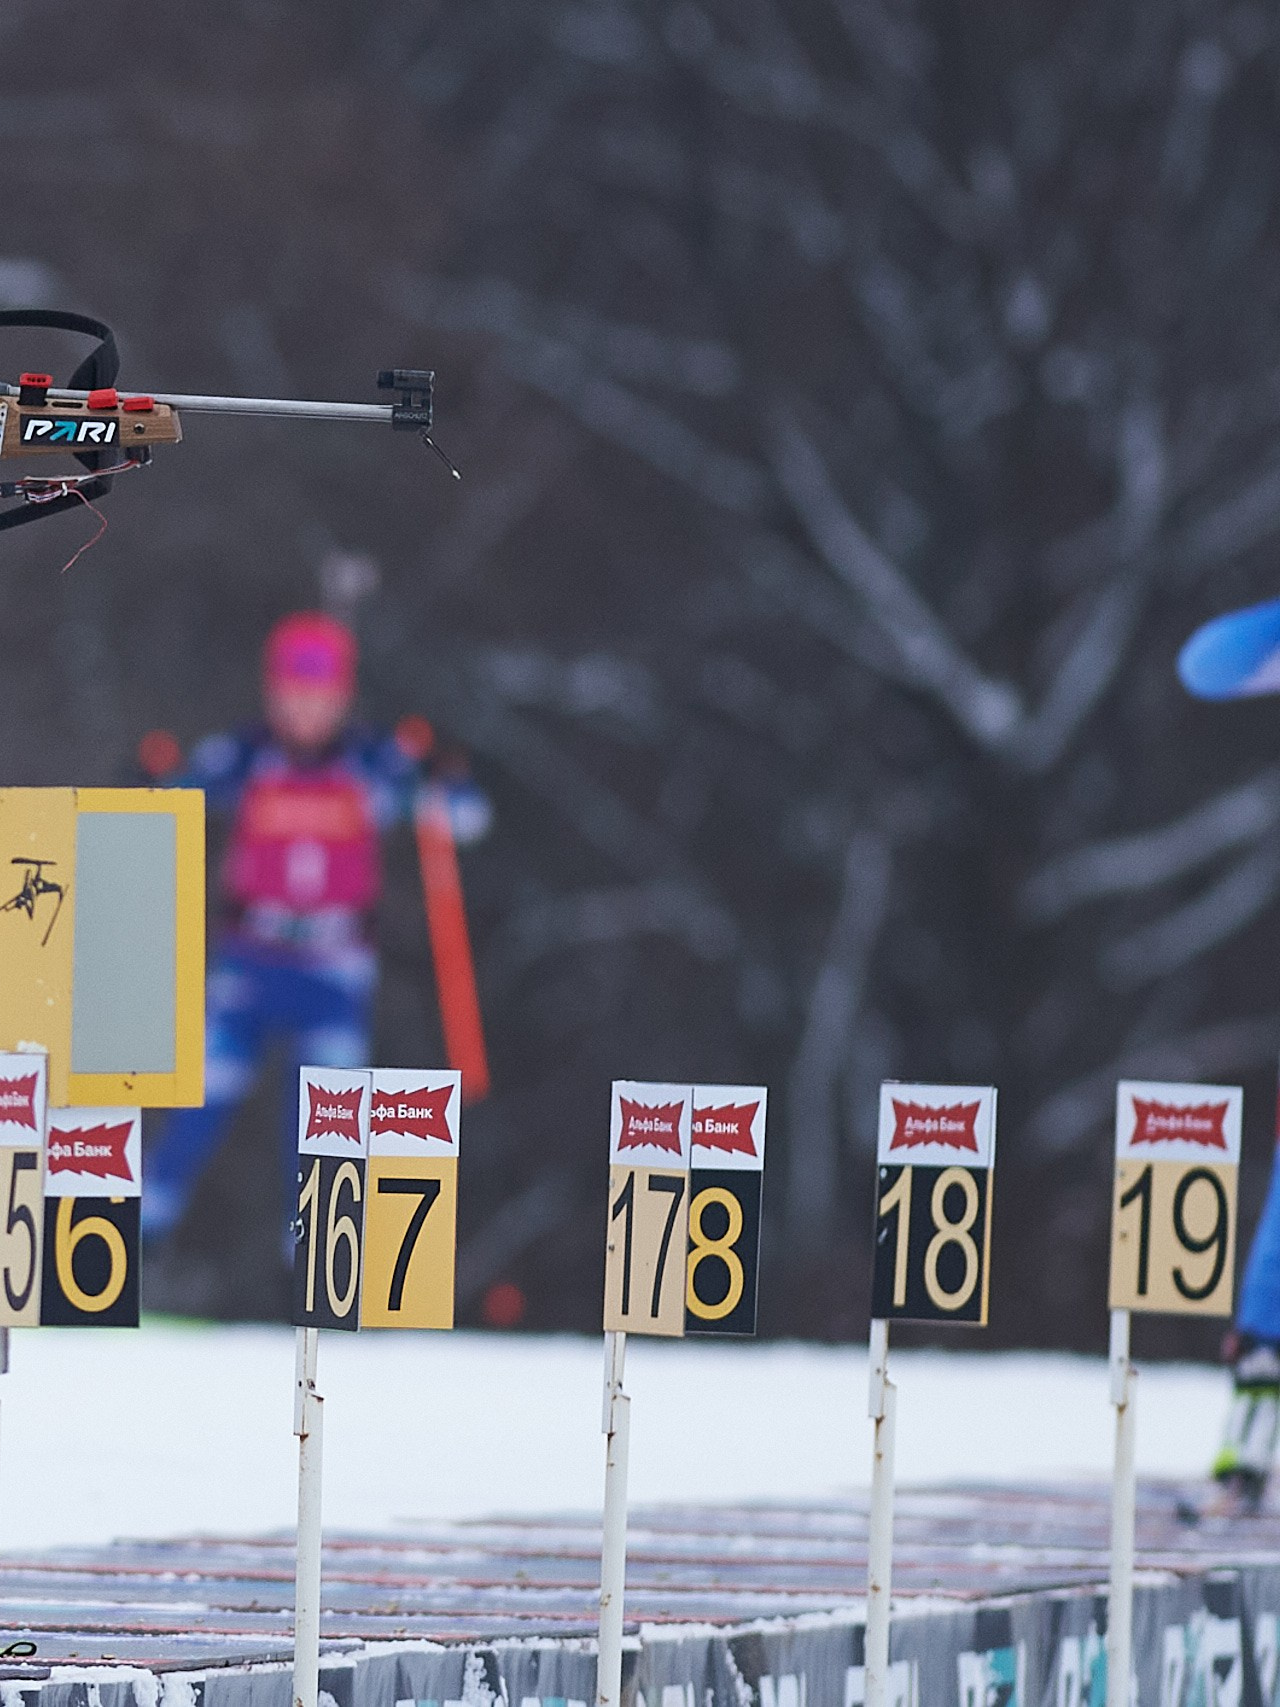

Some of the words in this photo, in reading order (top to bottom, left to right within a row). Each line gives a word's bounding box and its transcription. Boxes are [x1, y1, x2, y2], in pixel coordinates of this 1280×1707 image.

[23, 419, 117, 443] PARI
[73, 1141, 113, 1157] Банк
[397, 1104, 434, 1120] Банк
[628, 1116, 653, 1136] Альфа
[654, 1117, 673, 1133] Банк
[705, 1119, 739, 1134] Банк
[55, 1197, 128, 1313] 6
[299, 1158, 361, 1318] 16
[377, 1177, 441, 1312] 7
[612, 1171, 685, 1319] 17
[686, 1186, 744, 1321] 8
[879, 1165, 979, 1312] 18
[1120, 1163, 1229, 1301] 19
